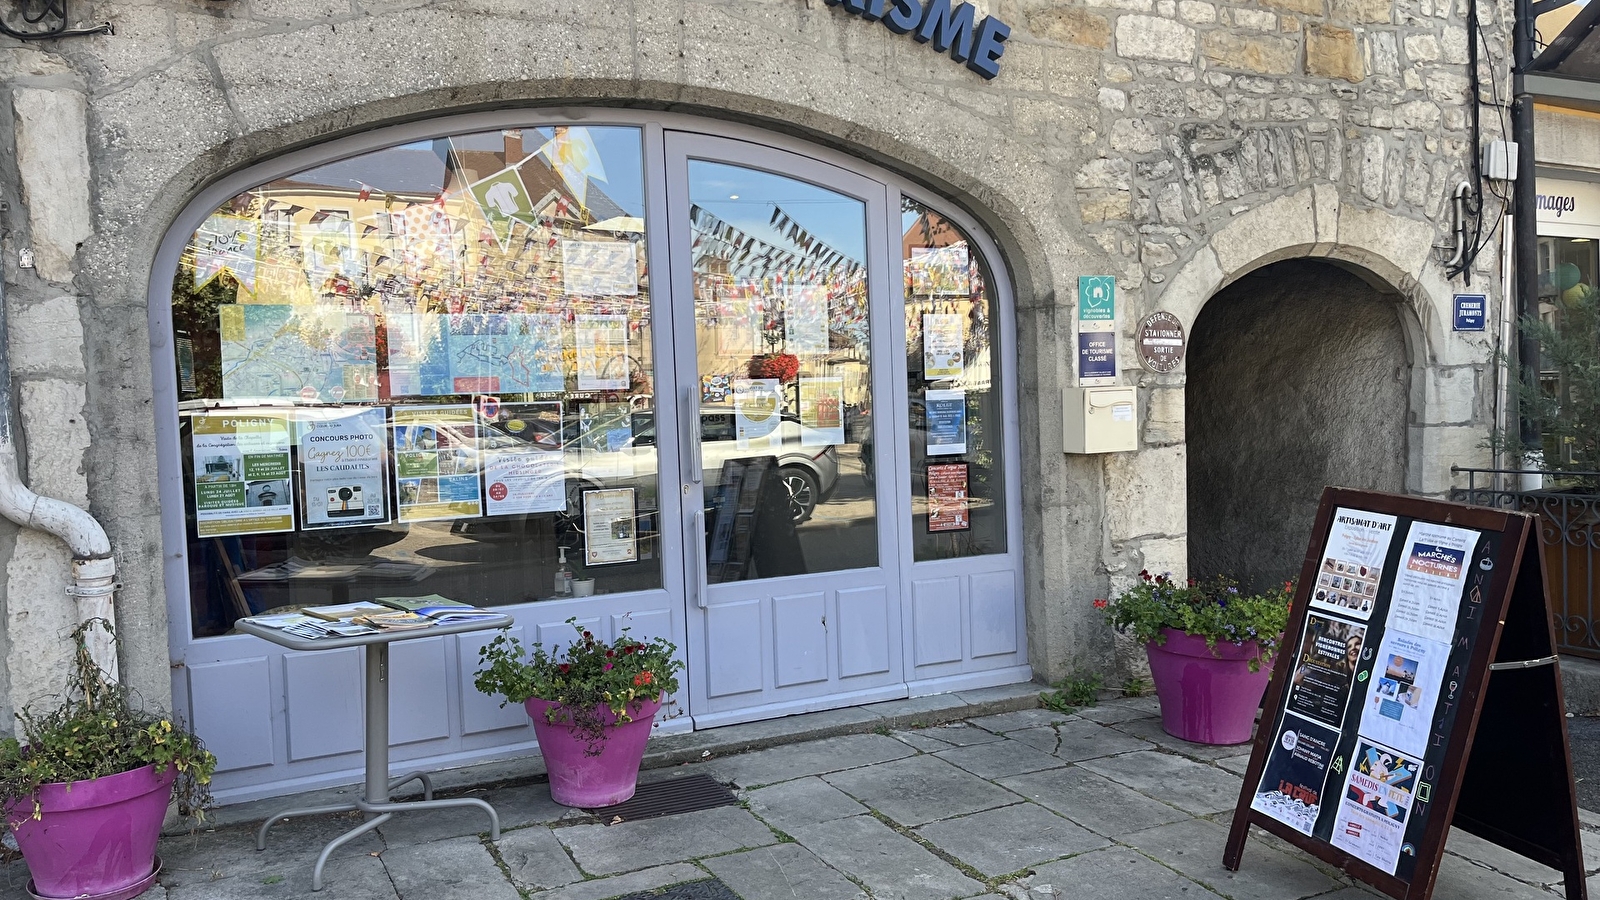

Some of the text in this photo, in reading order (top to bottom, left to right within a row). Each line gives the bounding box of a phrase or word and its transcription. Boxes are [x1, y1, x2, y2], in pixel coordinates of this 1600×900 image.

[1145, 329, 1182, 338] STATIONNER
[1088, 354, 1107, 362] CLASSÉ
[1147, 356, 1180, 371] VOITURES
[222, 418, 274, 428] POLIGNY
[310, 434, 374, 444] CONCOURS PHOTO
[308, 446, 345, 463] Gagnez
[346, 444, 373, 458] 100€
[1337, 515, 1392, 532] ARTISANAT D'ART
[1418, 551, 1456, 564] MARCHÉS
[1412, 559, 1458, 573] NOCTURNES
[1318, 635, 1346, 648] RENCONTRES
[1396, 637, 1414, 646] Balades
[1315, 642, 1346, 655] VIGNERONNES
[1317, 650, 1340, 660] ESTIVALES
[1410, 646, 1426, 654] Poligny
[1350, 774, 1379, 792] SAMEDIS
[1378, 785, 1388, 796] EN
